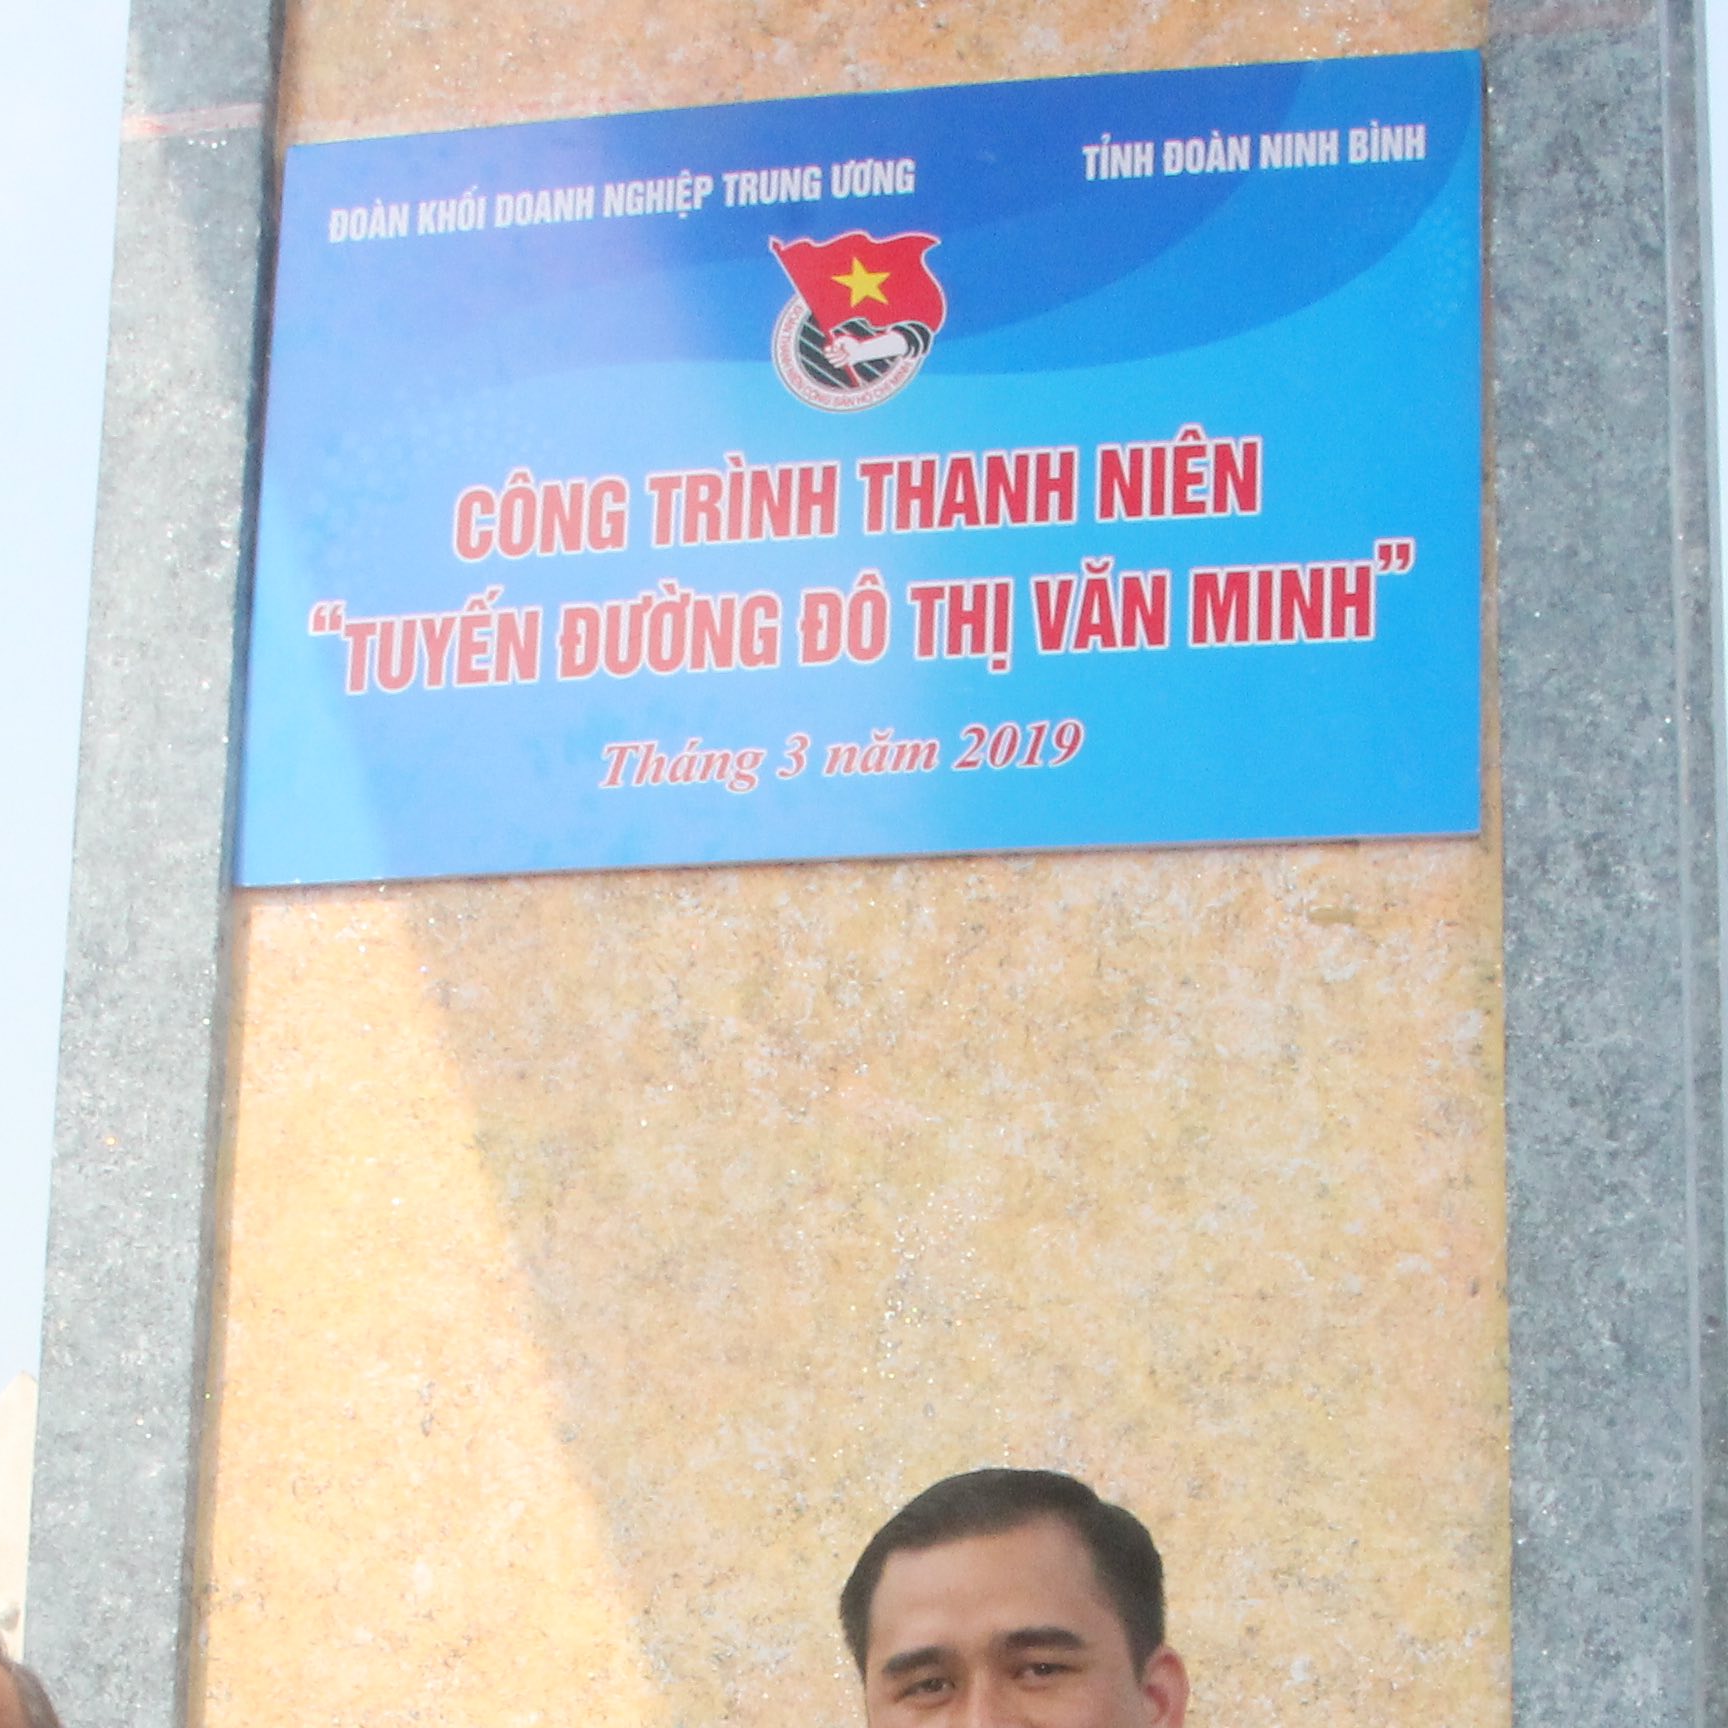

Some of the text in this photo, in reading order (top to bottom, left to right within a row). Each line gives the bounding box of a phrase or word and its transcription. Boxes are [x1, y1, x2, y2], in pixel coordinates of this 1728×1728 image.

[1083, 120, 1426, 181] TỈNH ĐOÀN NINH BÌNH
[328, 158, 917, 243] ĐOÀN KHỐI DOANH NGHIỆP TRUNG ƯƠNG
[453, 425, 1262, 561] CÔNG TRÌNH THANH NIÊN
[557, 579, 780, 679] ĐƯỜNG
[799, 569, 891, 665] ĐÔ
[908, 578, 1013, 672] THỊ
[1032, 557, 1169, 653] VĂN
[599, 720, 1084, 792] Tháng 3 năm 2019
